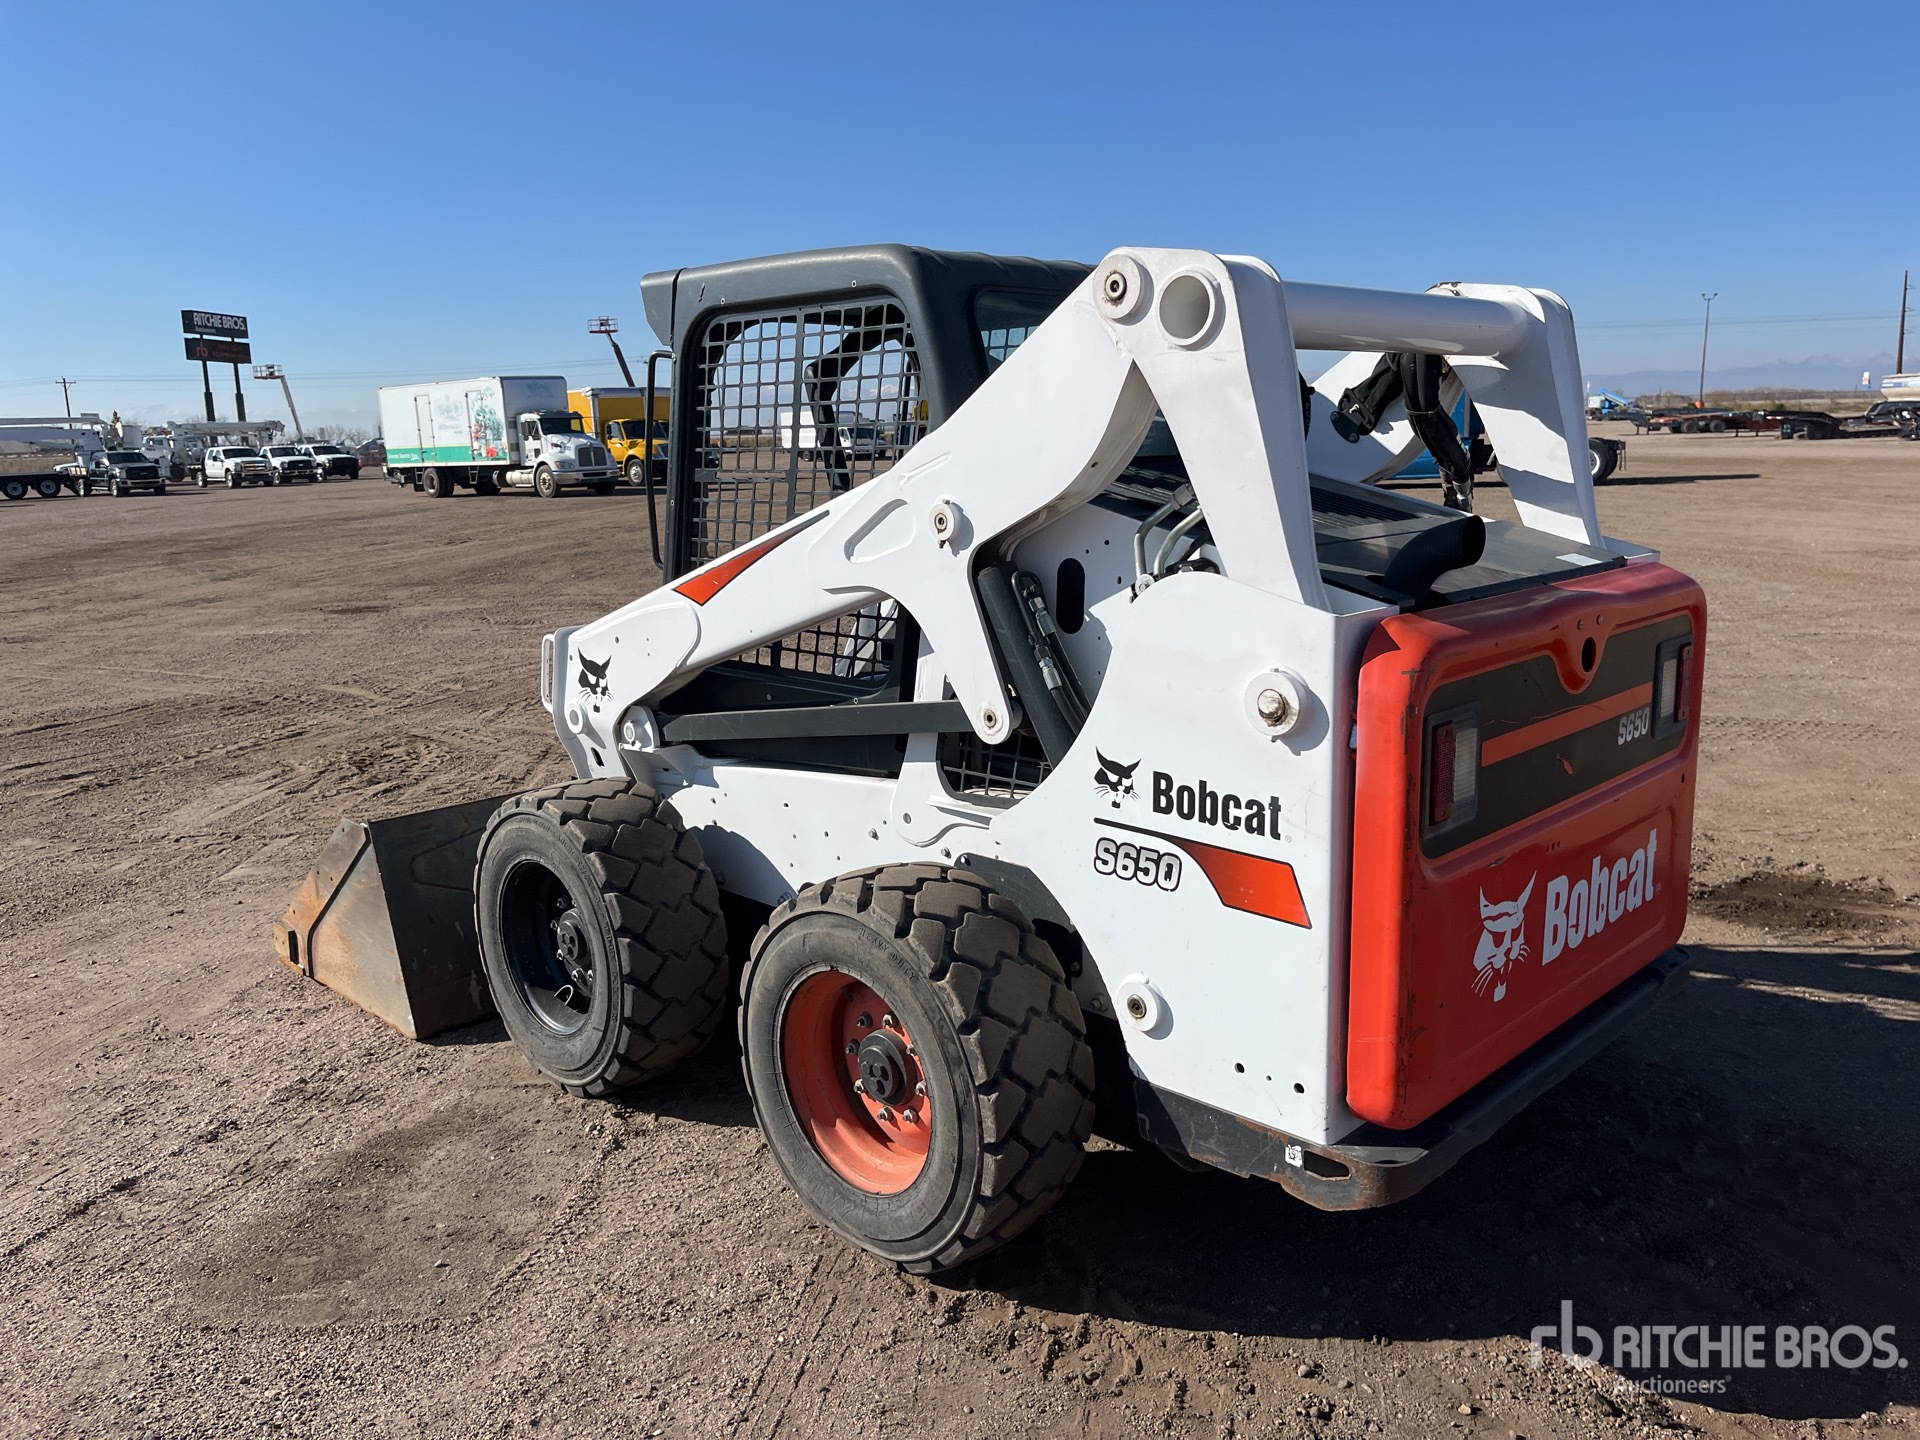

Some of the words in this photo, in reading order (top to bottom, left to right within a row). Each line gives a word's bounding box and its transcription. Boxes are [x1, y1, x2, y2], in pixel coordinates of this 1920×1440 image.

[193, 312, 222, 327] RITCHIE
[222, 316, 246, 330] BROS.
[1617, 707, 1650, 746] S650
[1152, 770, 1282, 841] Bobcat
[1093, 837, 1182, 892] S650
[1541, 828, 1658, 967] Bobcat
